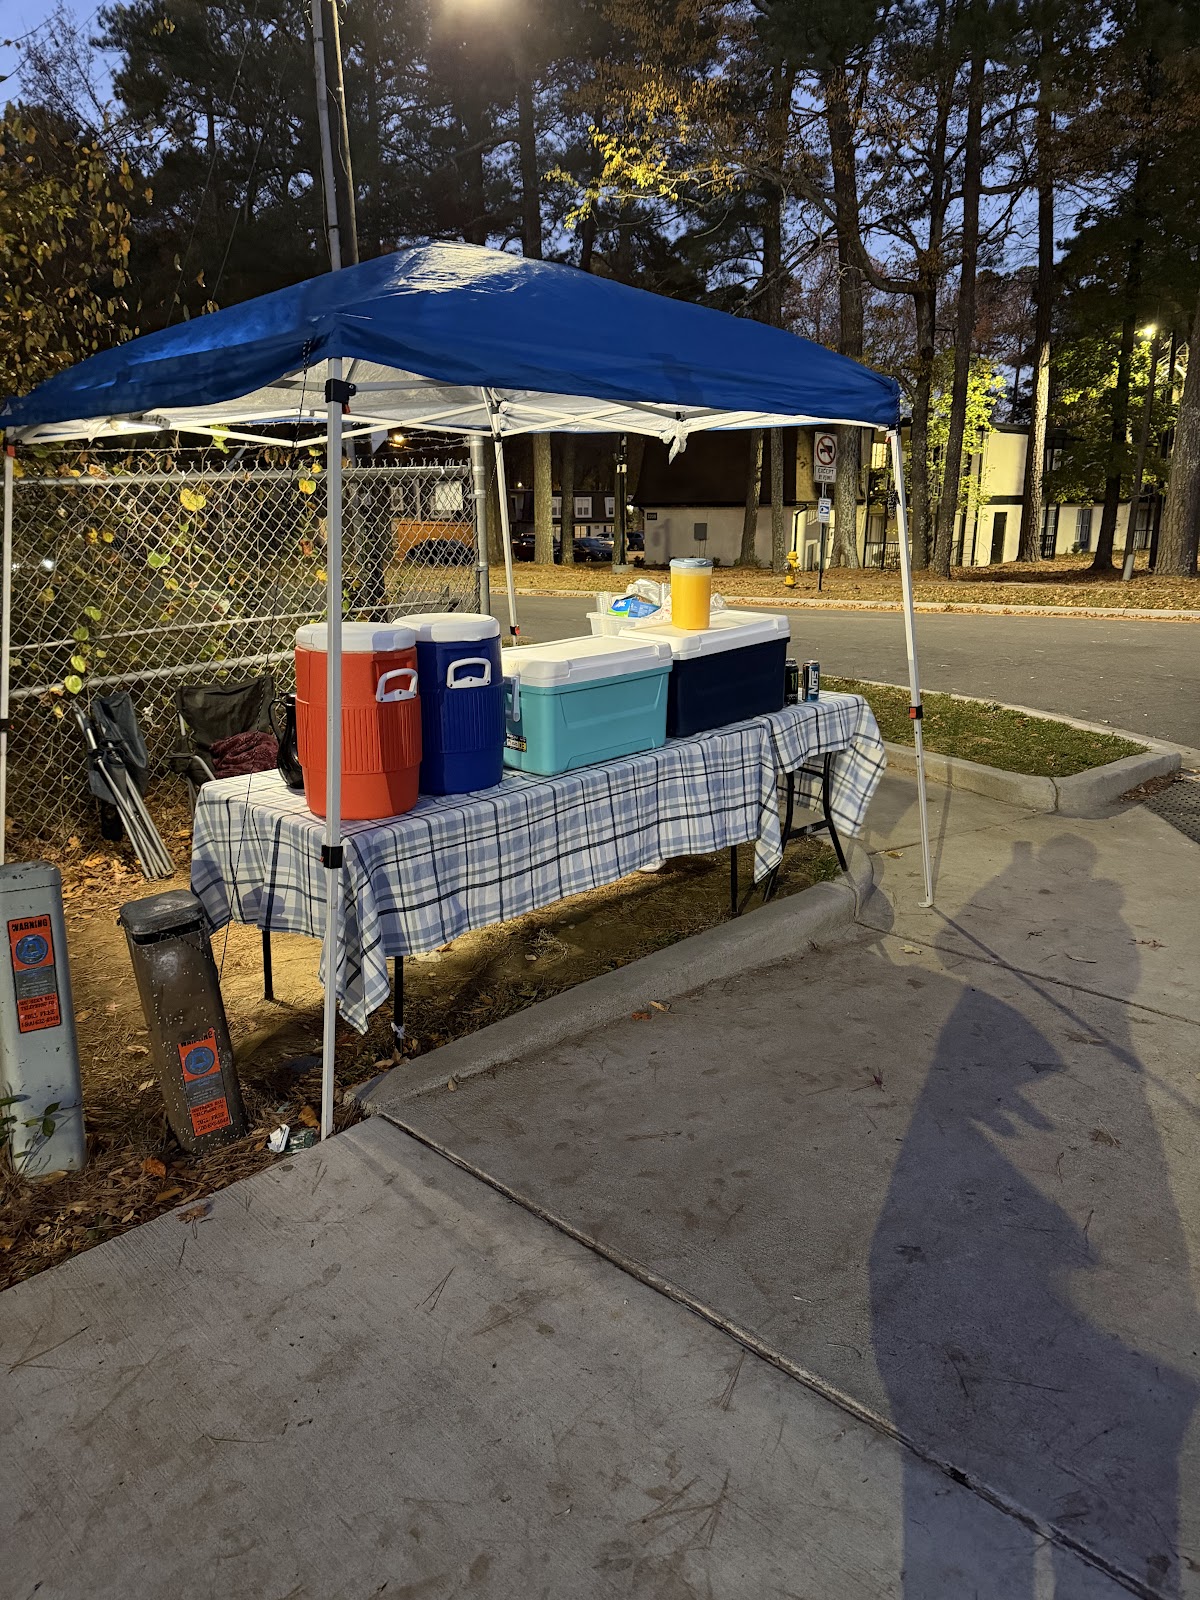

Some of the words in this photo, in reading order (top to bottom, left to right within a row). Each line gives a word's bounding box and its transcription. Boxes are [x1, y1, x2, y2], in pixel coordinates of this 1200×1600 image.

[818, 467, 834, 475] EXCEPT
[808, 669, 819, 695] NOS
[12, 919, 48, 932] WARNING
